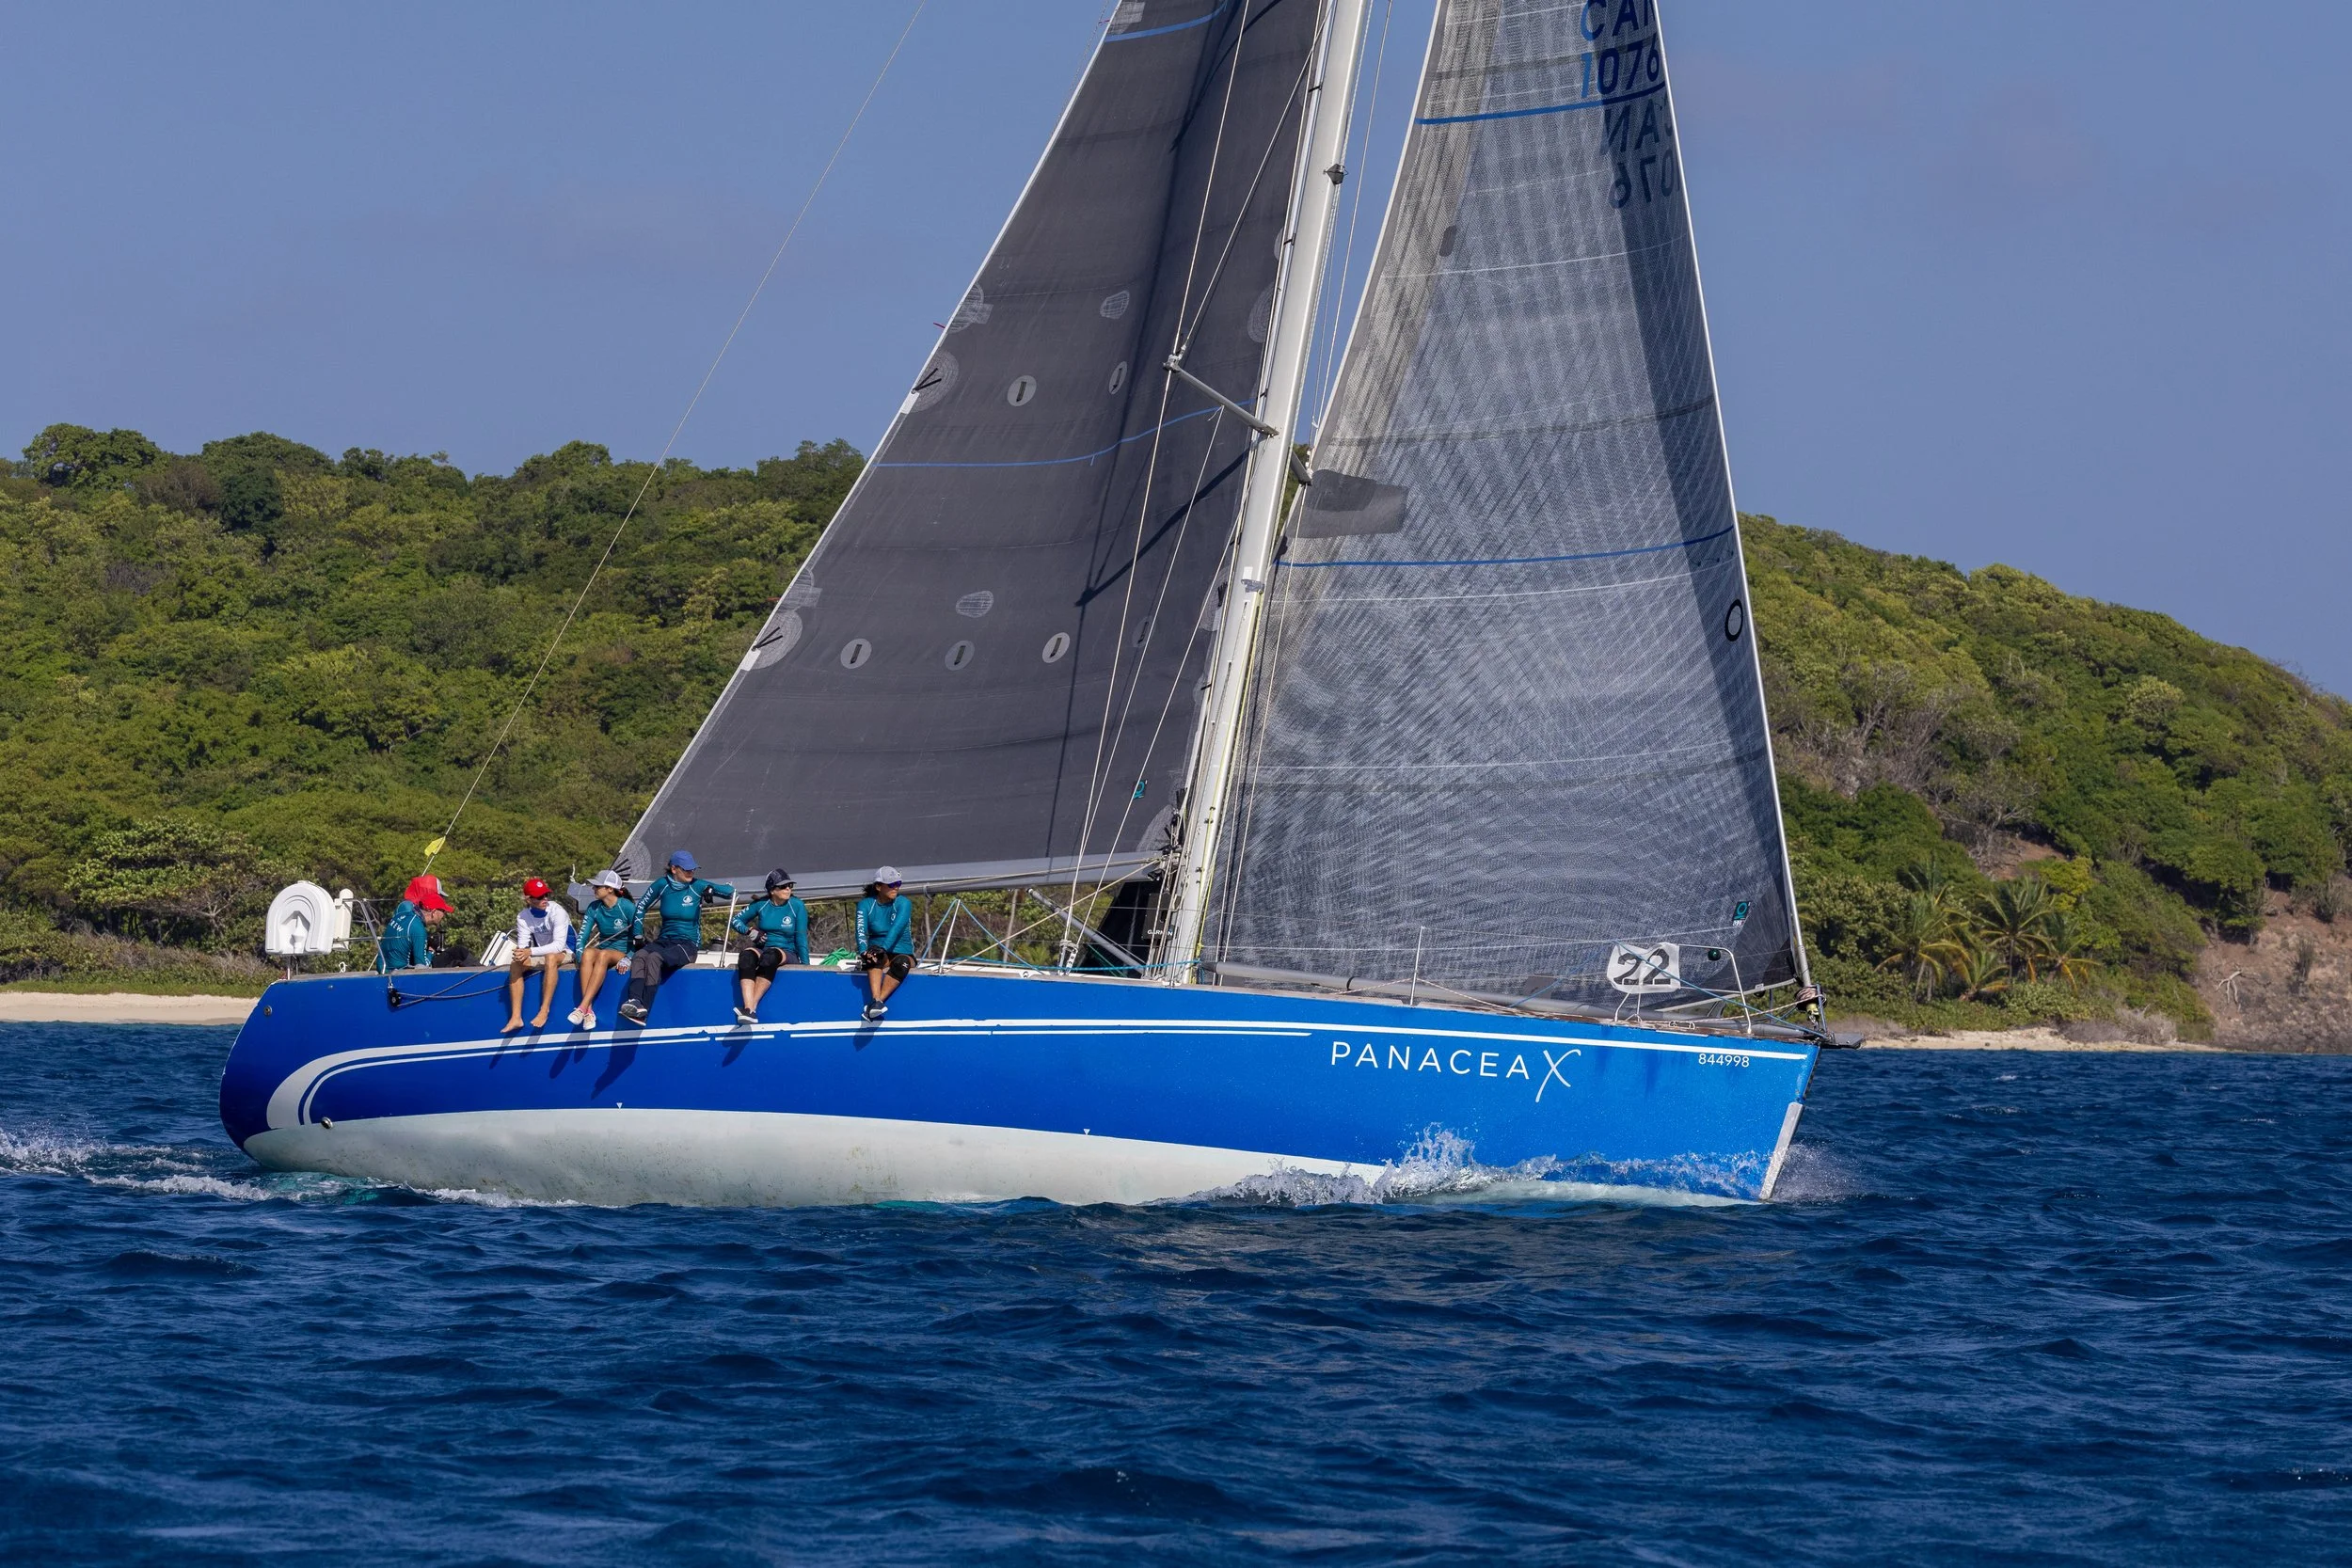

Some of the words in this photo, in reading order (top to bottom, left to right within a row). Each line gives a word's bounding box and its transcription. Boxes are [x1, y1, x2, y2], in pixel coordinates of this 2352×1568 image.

[1581, 32, 1661, 98] 1076
[1147, 928, 1174, 937] GARN
[1613, 948, 1671, 986] 22
[1330, 1040, 1530, 1081] PANACEA
[1534, 1049, 1581, 1103] X
[1698, 1053, 1750, 1068] 844998
